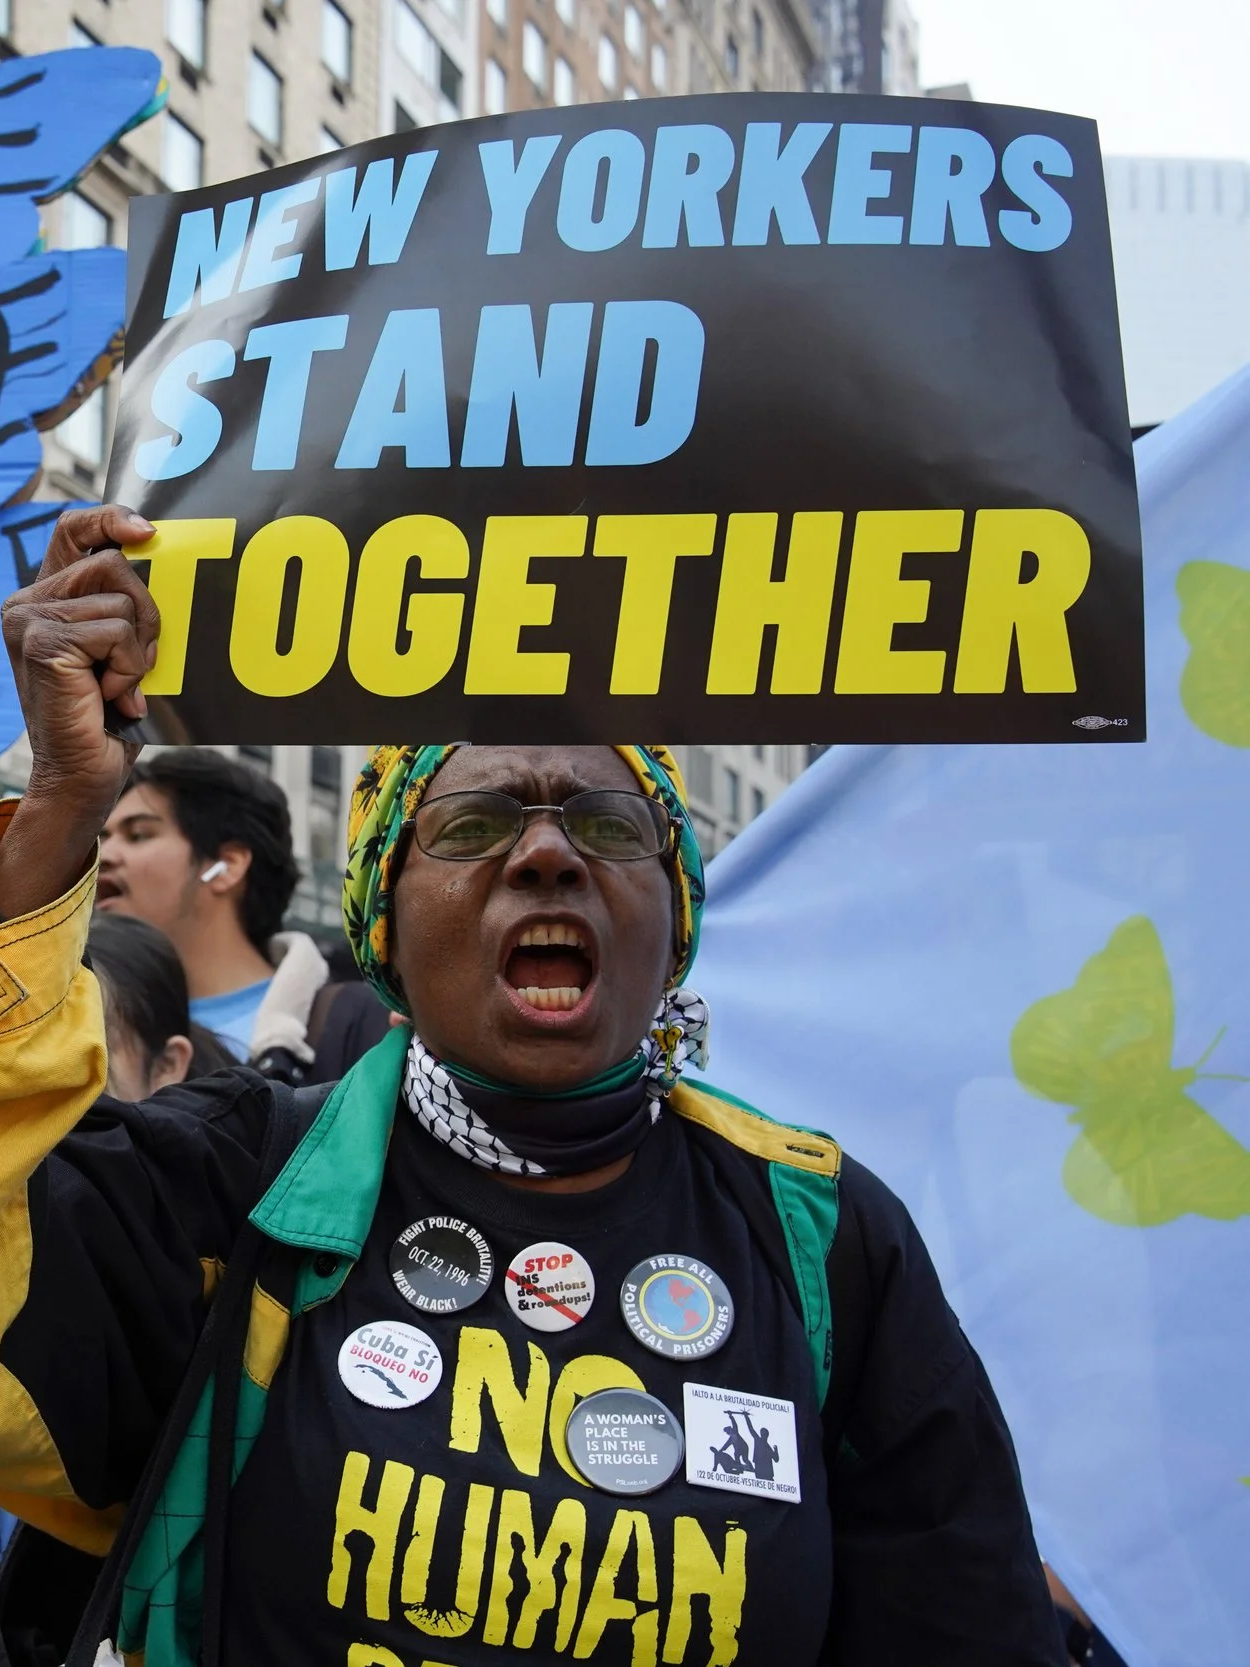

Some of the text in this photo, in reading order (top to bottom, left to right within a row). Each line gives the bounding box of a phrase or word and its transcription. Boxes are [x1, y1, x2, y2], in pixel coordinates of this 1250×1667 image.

[164, 122, 1075, 319] NEW YORKERS
[134, 300, 706, 482] STAND
[122, 508, 1092, 698] TOGETHER
[1112, 718, 1128, 726] 423
[398, 1216, 492, 1285] FIGHT POLICE BRUTALITY!
[524, 1253, 573, 1273] STOP
[408, 1245, 471, 1287] OCT. 22, 1996
[516, 1273, 540, 1286] INS
[649, 1257, 713, 1285] FREE ALL
[392, 1269, 458, 1311] WEAR BLACK!
[517, 1281, 586, 1297] detentions
[624, 1283, 729, 1355] POLITICAL PRISONERS
[357, 1328, 409, 1360] Cuba
[350, 1344, 429, 1384] BLOQUEO NO
[715, 1394, 724, 1402] LA
[724, 1394, 761, 1408] BRUTALIDAD
[584, 1414, 594, 1425] A
[585, 1427, 628, 1438] PLACE
[586, 1441, 646, 1451] IS IN THE
[588, 1454, 658, 1465] STRUGGLE
[706, 1472, 715, 1481] DE
[767, 1483, 775, 1491] DE
[327, 1450, 748, 1667] HUMAN
